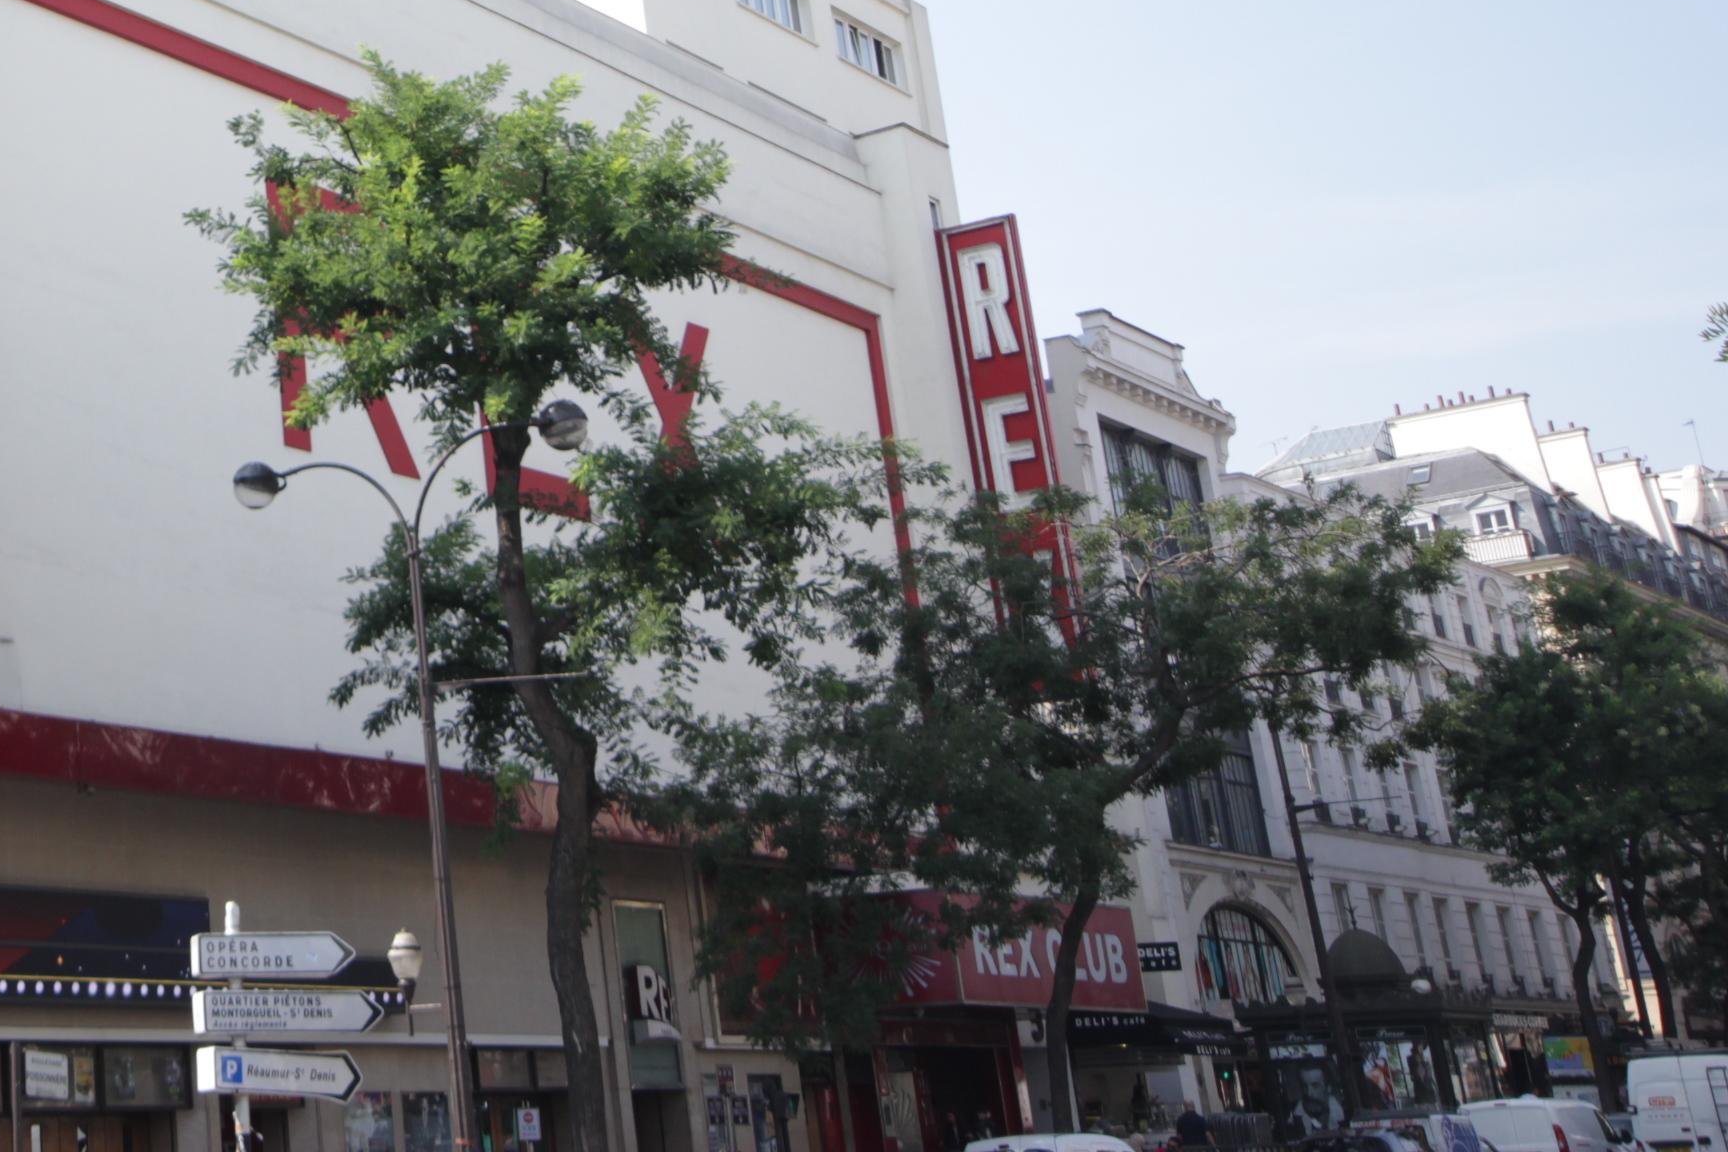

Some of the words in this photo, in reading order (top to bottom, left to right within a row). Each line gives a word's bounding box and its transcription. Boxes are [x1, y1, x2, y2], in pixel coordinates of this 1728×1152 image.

[206, 938, 259, 953] OPÉRA
[972, 924, 1041, 978] REX
[1137, 946, 1176, 958] DELI'S
[206, 956, 294, 968] CONCORDE
[211, 997, 269, 1008] QUARTIER
[273, 994, 322, 1007] PIÉTONS
[211, 1008, 282, 1019] MONTORGUEIL
[303, 1008, 334, 1018] DENIS
[1075, 1016, 1120, 1027] DELI'S
[310, 1068, 337, 1082] Denis
